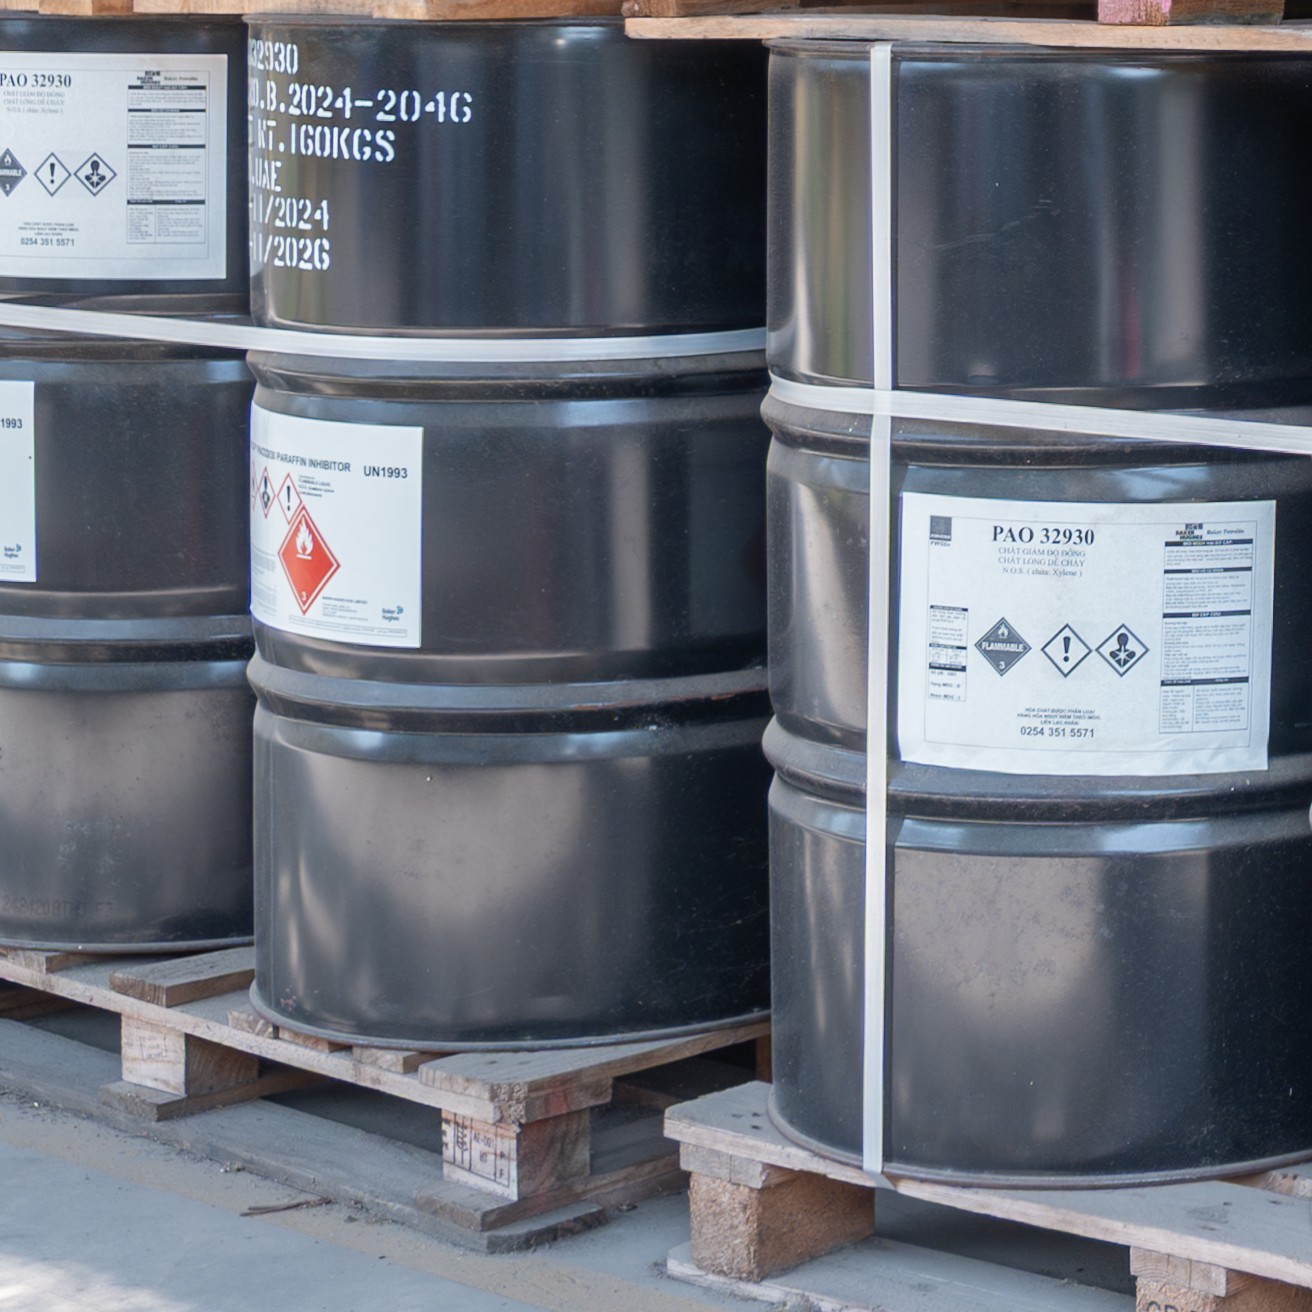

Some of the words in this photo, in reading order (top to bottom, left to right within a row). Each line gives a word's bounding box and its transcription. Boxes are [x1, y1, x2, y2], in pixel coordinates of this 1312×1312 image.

[0, 73, 27, 88] PAO
[31, 74, 72, 88] 32930
[251, 157, 282, 192] .UAE
[20, 237, 38, 245] 0254
[40, 237, 53, 246] 351
[56, 238, 75, 246] 5571
[1, 418, 23, 429] 1993
[277, 452, 307, 467] PARAFFIN
[309, 459, 351, 472] INHIBITOR
[364, 466, 408, 478] UN1993
[992, 525, 1034, 544] PAO
[1040, 527, 1094, 546] 32930
[302, 591, 307, 601] 3
[982, 642, 1024, 652] FLAMMABLE
[999, 661, 1005, 669] 3
[1020, 726, 1044, 736] 0254
[1048, 727, 1065, 737] 351
[1070, 728, 1094, 738] 5571
